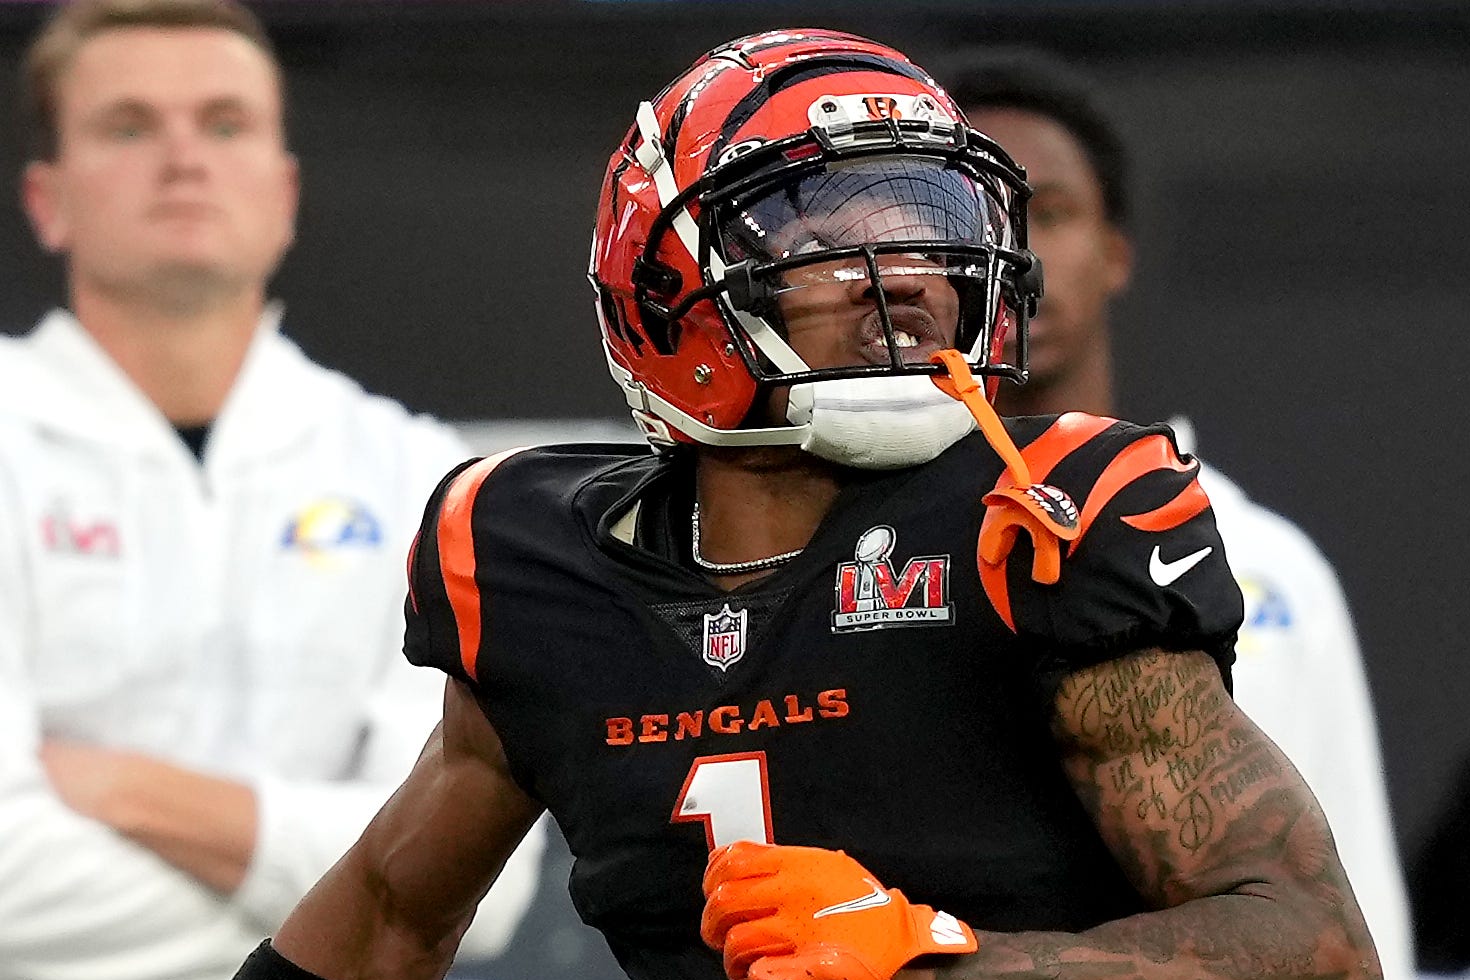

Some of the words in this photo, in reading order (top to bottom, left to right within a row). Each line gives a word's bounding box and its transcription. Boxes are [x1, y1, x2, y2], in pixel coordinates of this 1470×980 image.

[841, 560, 944, 613] LVI
[846, 611, 890, 623] SUPER
[895, 610, 938, 620] BOWL
[709, 634, 739, 660] NFL
[605, 688, 851, 746] BENGALS
